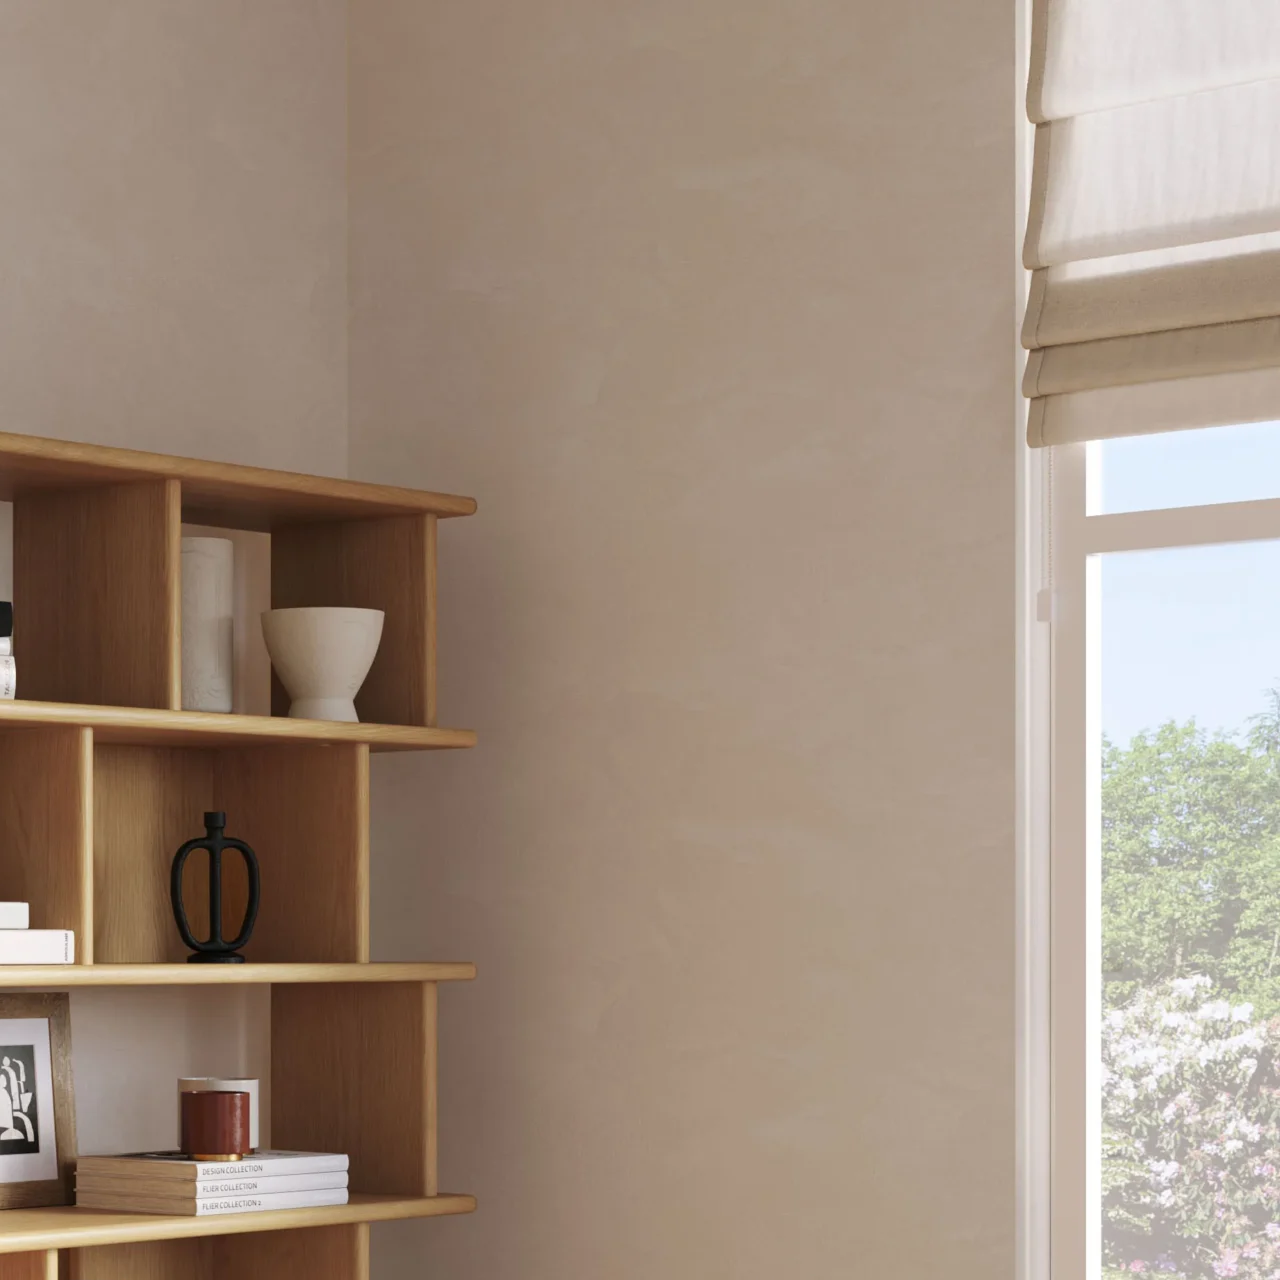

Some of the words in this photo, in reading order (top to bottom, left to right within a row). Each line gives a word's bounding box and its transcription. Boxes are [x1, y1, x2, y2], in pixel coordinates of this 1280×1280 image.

[202, 1168, 225, 1176] DESIGN
[225, 1164, 263, 1174] COLLECTION
[202, 1184, 220, 1193] FLIER
[220, 1182, 258, 1192] COLLECTION
[202, 1202, 219, 1210] FLIER
[219, 1199, 257, 1209] COLLECTION
